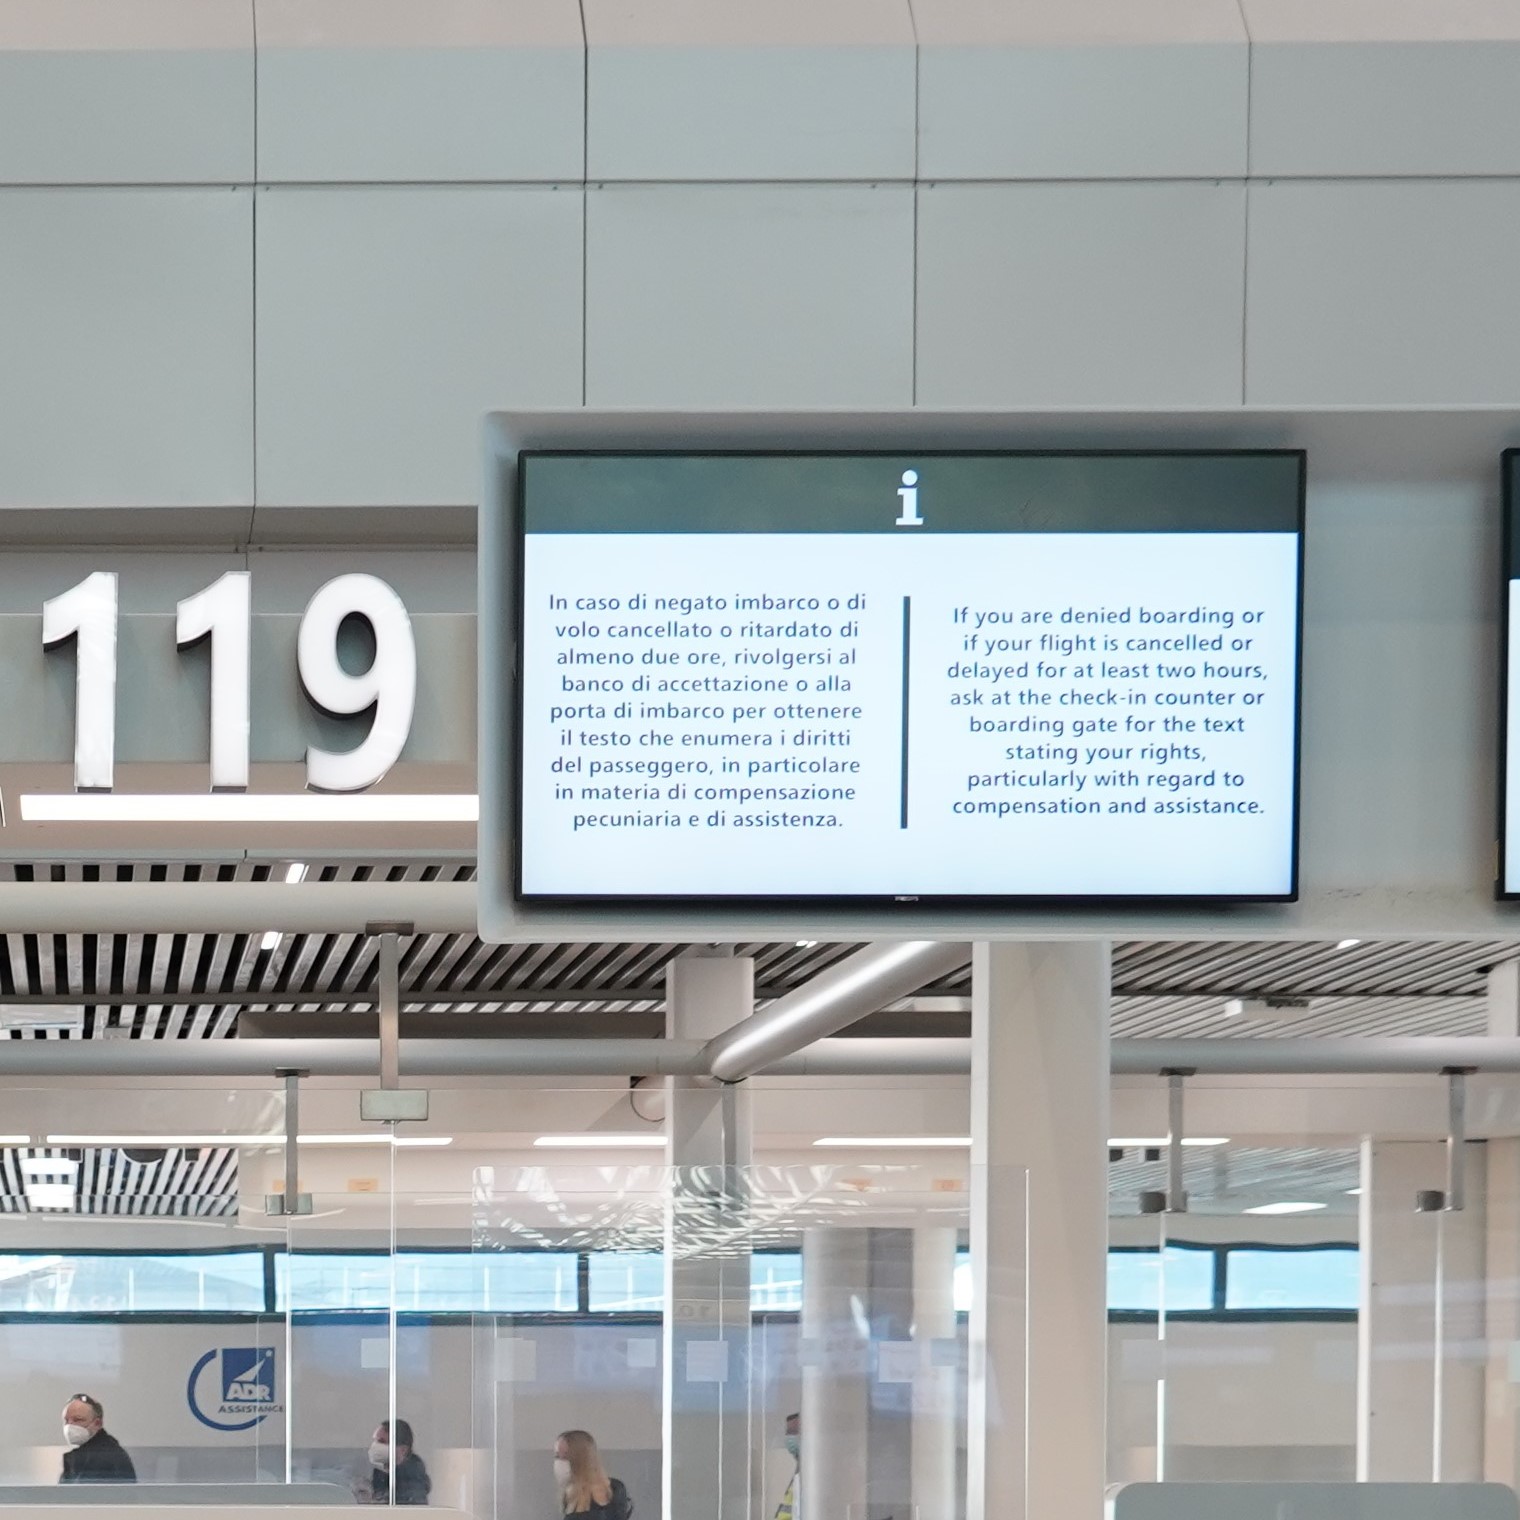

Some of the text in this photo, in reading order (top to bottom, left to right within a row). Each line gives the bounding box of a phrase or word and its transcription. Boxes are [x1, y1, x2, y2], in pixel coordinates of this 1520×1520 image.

[549, 593, 866, 616] In caso di negato imbarco o di
[555, 620, 858, 638] volo cancellato o ritardato di
[954, 606, 1265, 629] If you are denied boarding or
[964, 633, 1253, 657] if your flight is cancelled or
[557, 647, 856, 670] almeno due ore, rivolgersi al
[42, 571, 416, 792] 119
[562, 674, 851, 692] banco di accettazione o alla
[947, 661, 1268, 684] delayed for at least two hours,
[950, 688, 1265, 706] ask at the check-in counter or
[550, 702, 862, 724] porta di imbarco per ottenere
[970, 714, 1245, 738] boarding gate for the text
[561, 729, 850, 747] il testo che enumera i diritti
[1006, 742, 1206, 765] stating your rights,
[551, 756, 860, 779] del passeggero, in particolare
[968, 769, 1245, 793] particularly with regard to
[555, 783, 856, 805] in materia di compensazione
[952, 796, 1265, 819] compensation and assistance.
[573, 810, 843, 832] pecuniaria e di assistenza.
[226, 1382, 271, 1401] ADR
